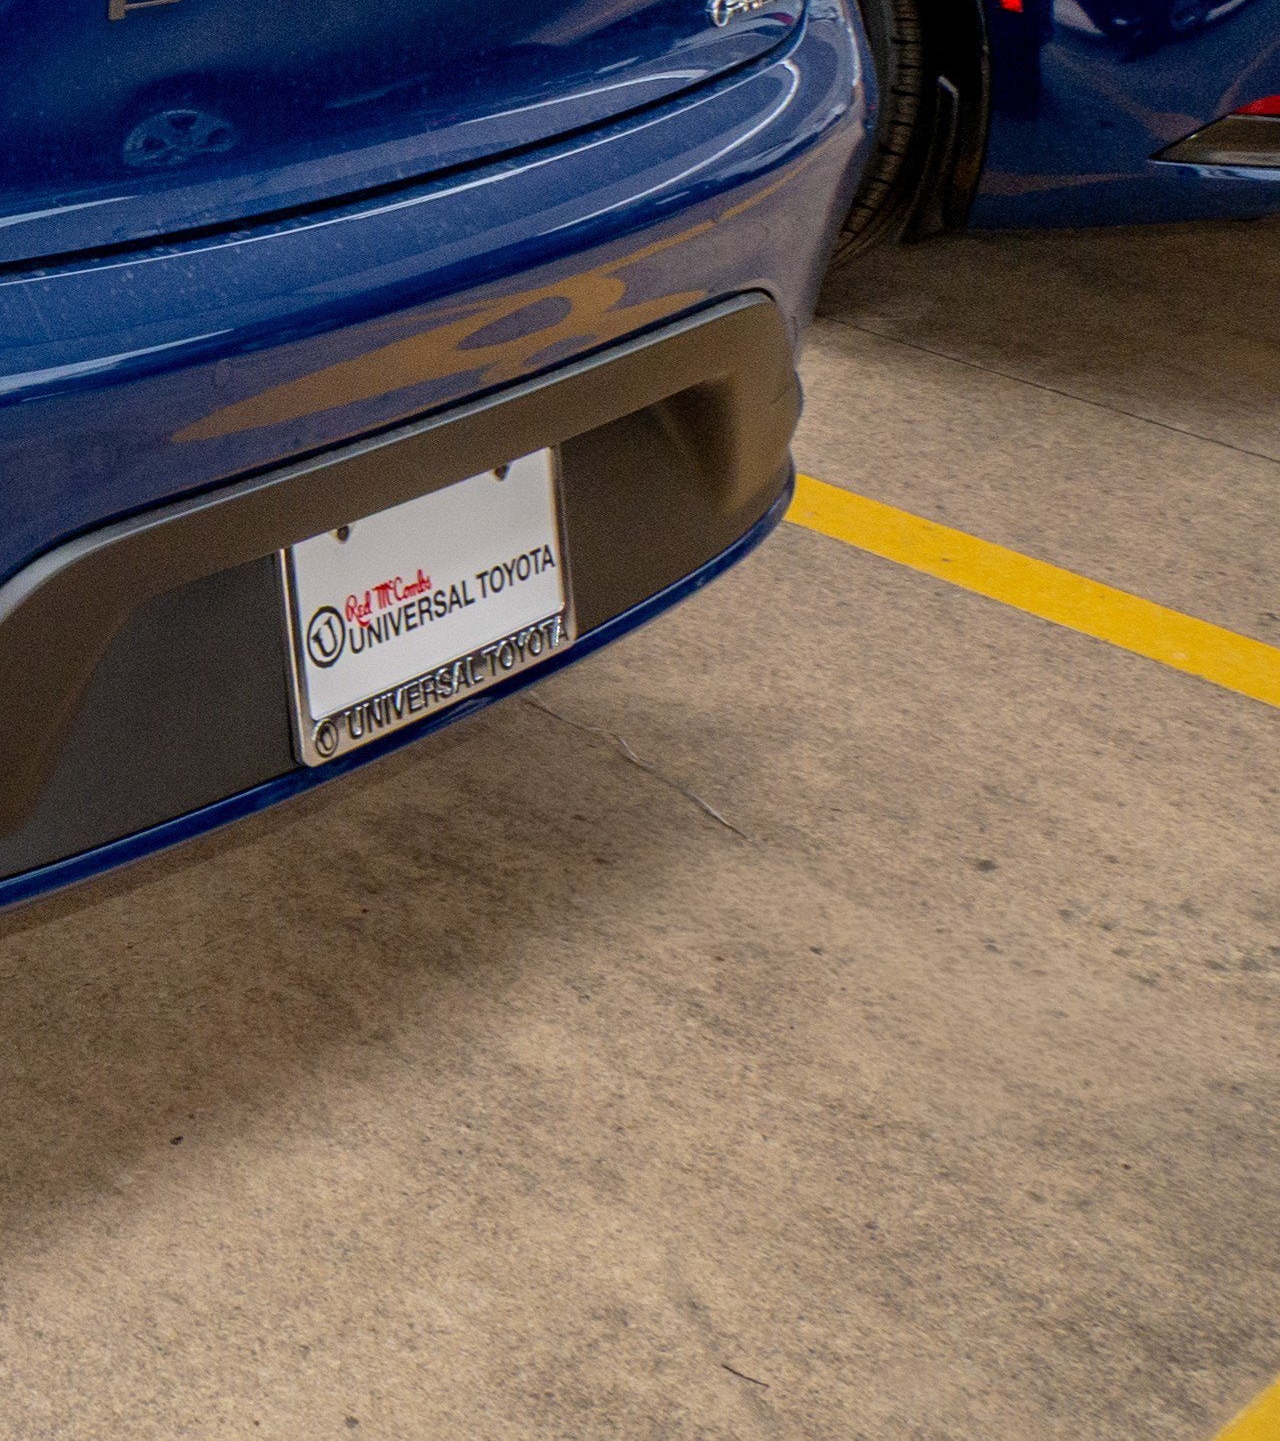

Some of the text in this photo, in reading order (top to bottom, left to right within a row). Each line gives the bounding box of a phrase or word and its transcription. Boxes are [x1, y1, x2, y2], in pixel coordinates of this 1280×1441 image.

[345, 594, 372, 627] Red
[349, 580, 475, 654] UNIVERSAL
[476, 544, 556, 599] TOYOTA
[344, 655, 484, 740] UNIVERSAL
[482, 615, 570, 670] TOYOTA
